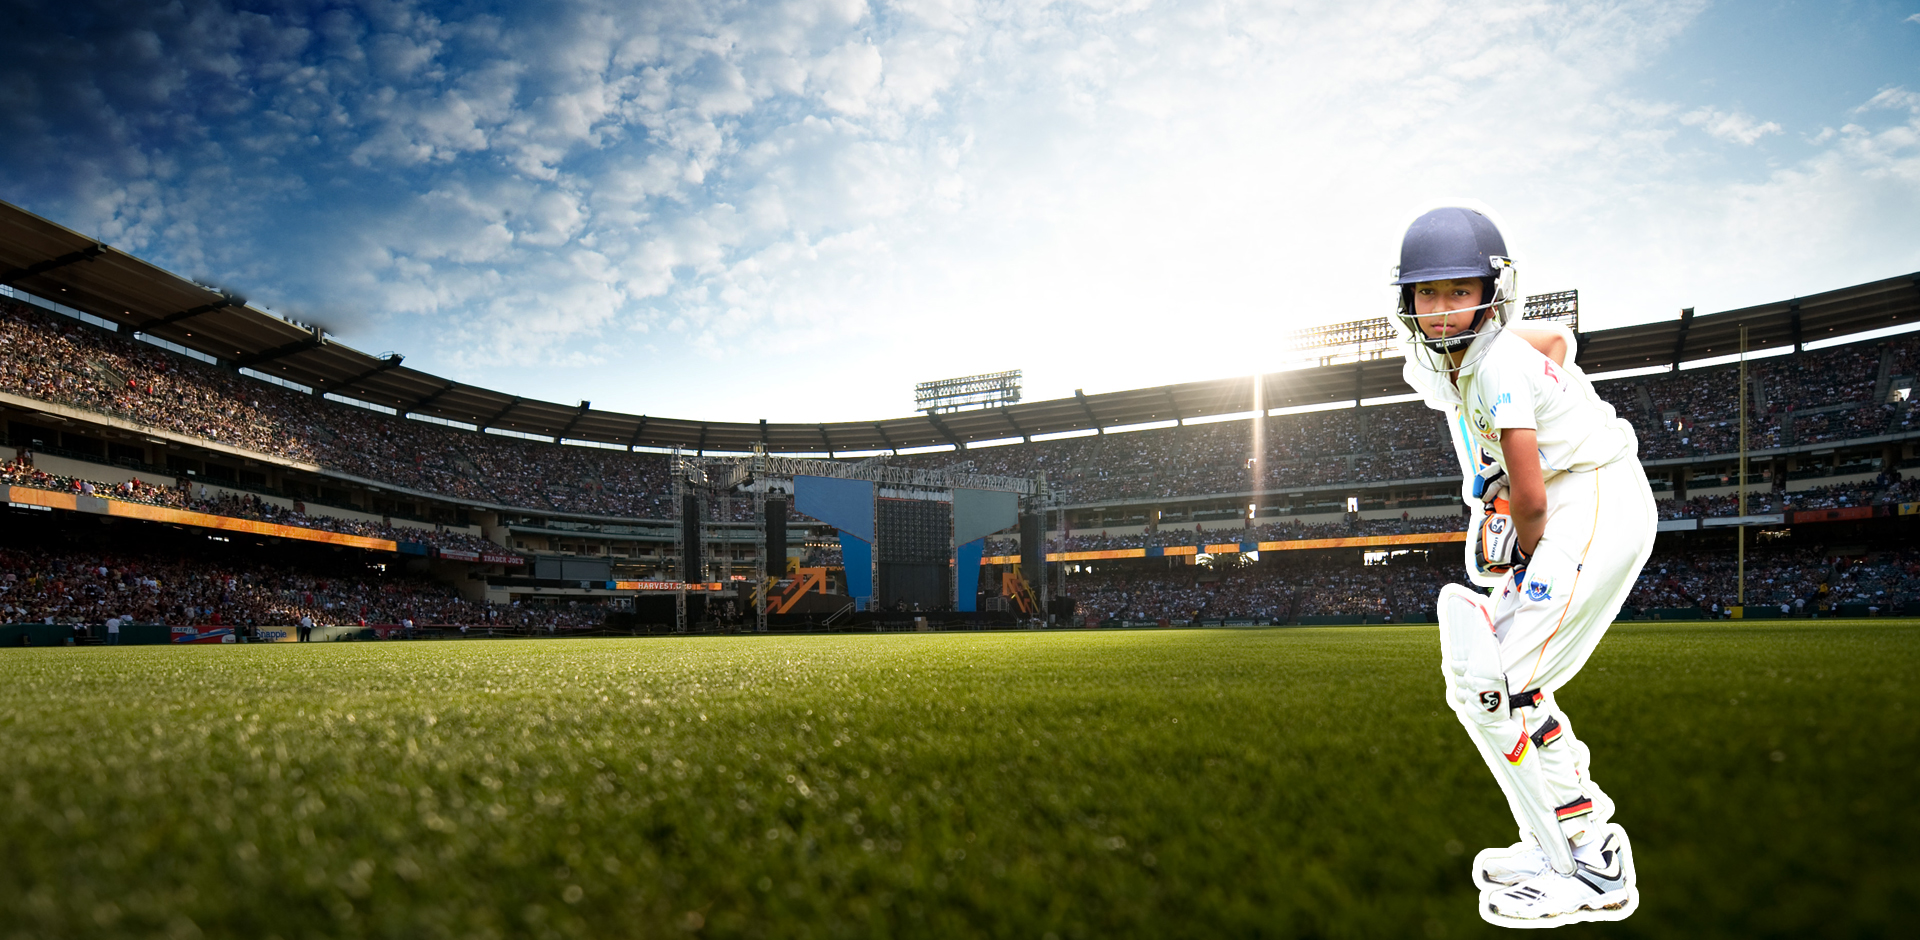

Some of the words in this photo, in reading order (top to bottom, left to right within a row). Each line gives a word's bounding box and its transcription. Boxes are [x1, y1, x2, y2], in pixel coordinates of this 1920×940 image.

[483, 555, 507, 563] TRADER
[256, 628, 287, 641] Snapple
[1513, 742, 1525, 757] CLUB
